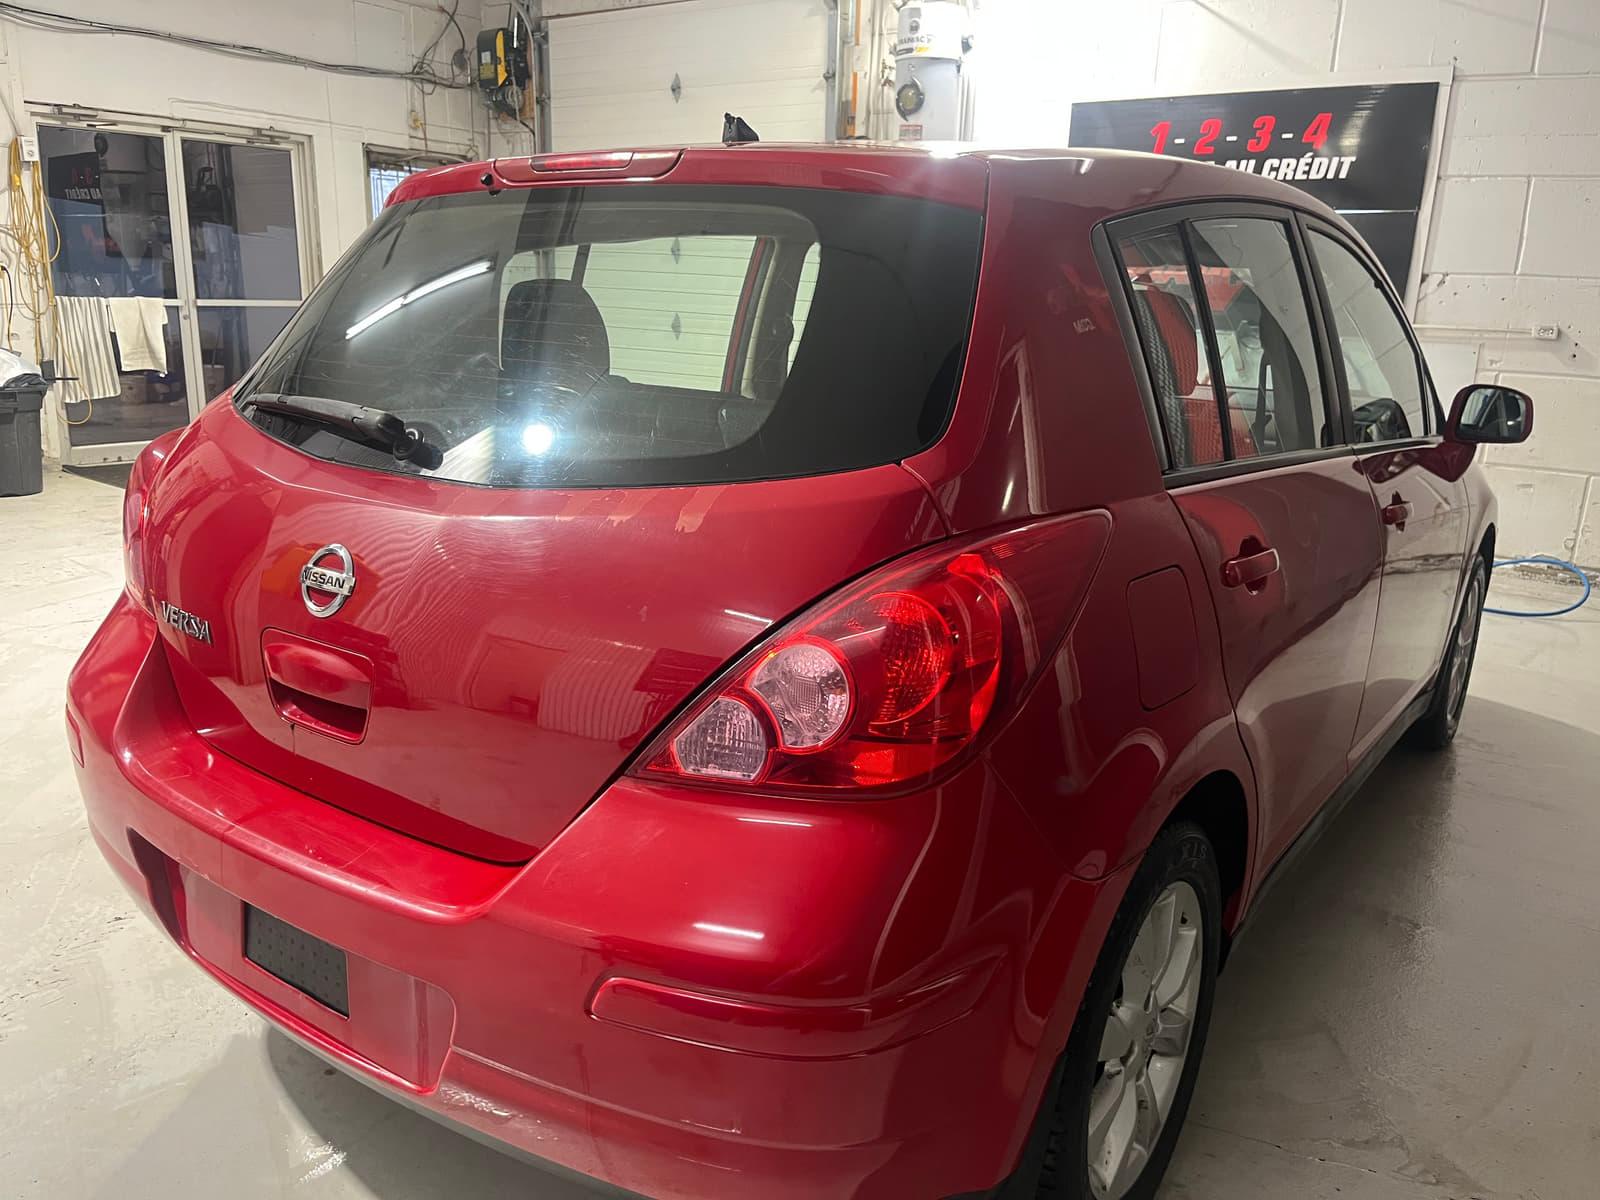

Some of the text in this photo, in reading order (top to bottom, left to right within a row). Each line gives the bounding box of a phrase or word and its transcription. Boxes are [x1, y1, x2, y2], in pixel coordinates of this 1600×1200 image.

[1261, 152, 1356, 181] CRÉDIT
[302, 567, 346, 589] NISSAN
[160, 600, 213, 645] VERSA
